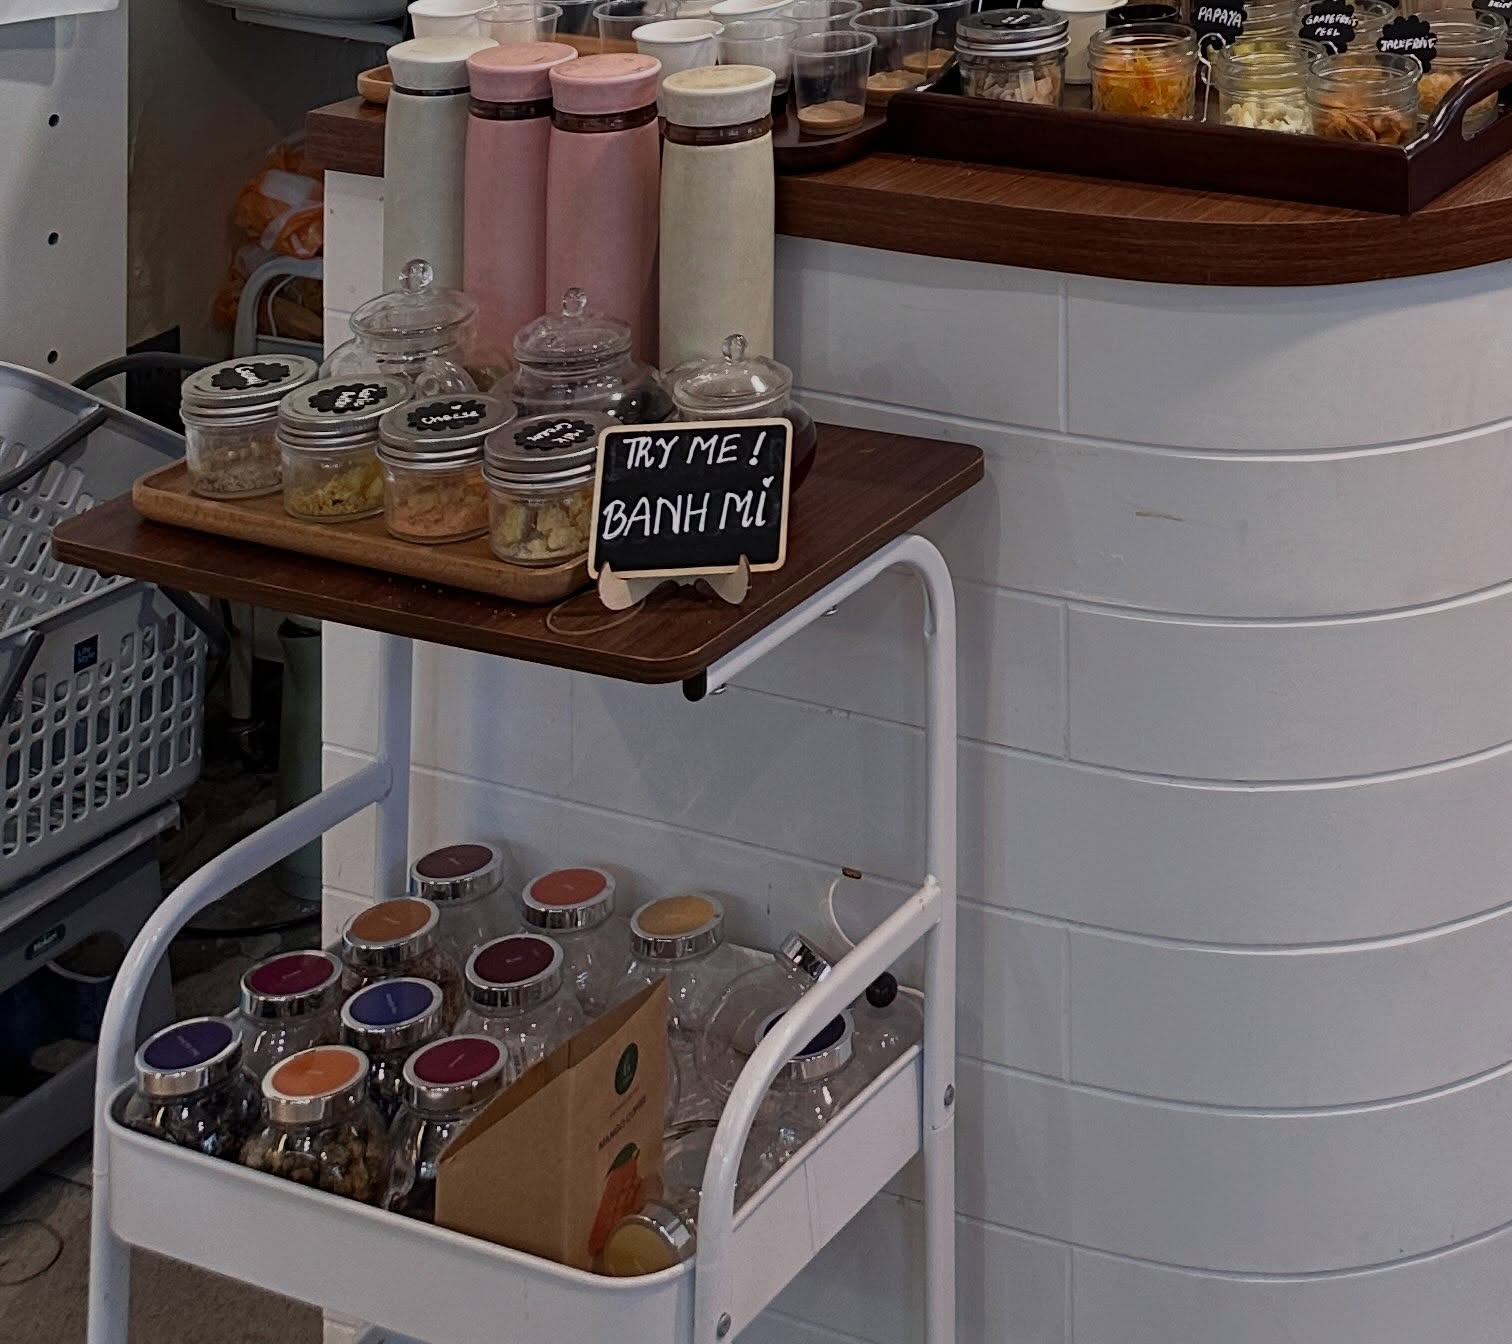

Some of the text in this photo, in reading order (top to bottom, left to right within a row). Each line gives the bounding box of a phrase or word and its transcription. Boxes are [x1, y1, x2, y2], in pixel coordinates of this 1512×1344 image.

[1197, 6, 1242, 28] PAPAYA
[622, 435, 680, 470] TRY
[602, 492, 711, 541] BANH
